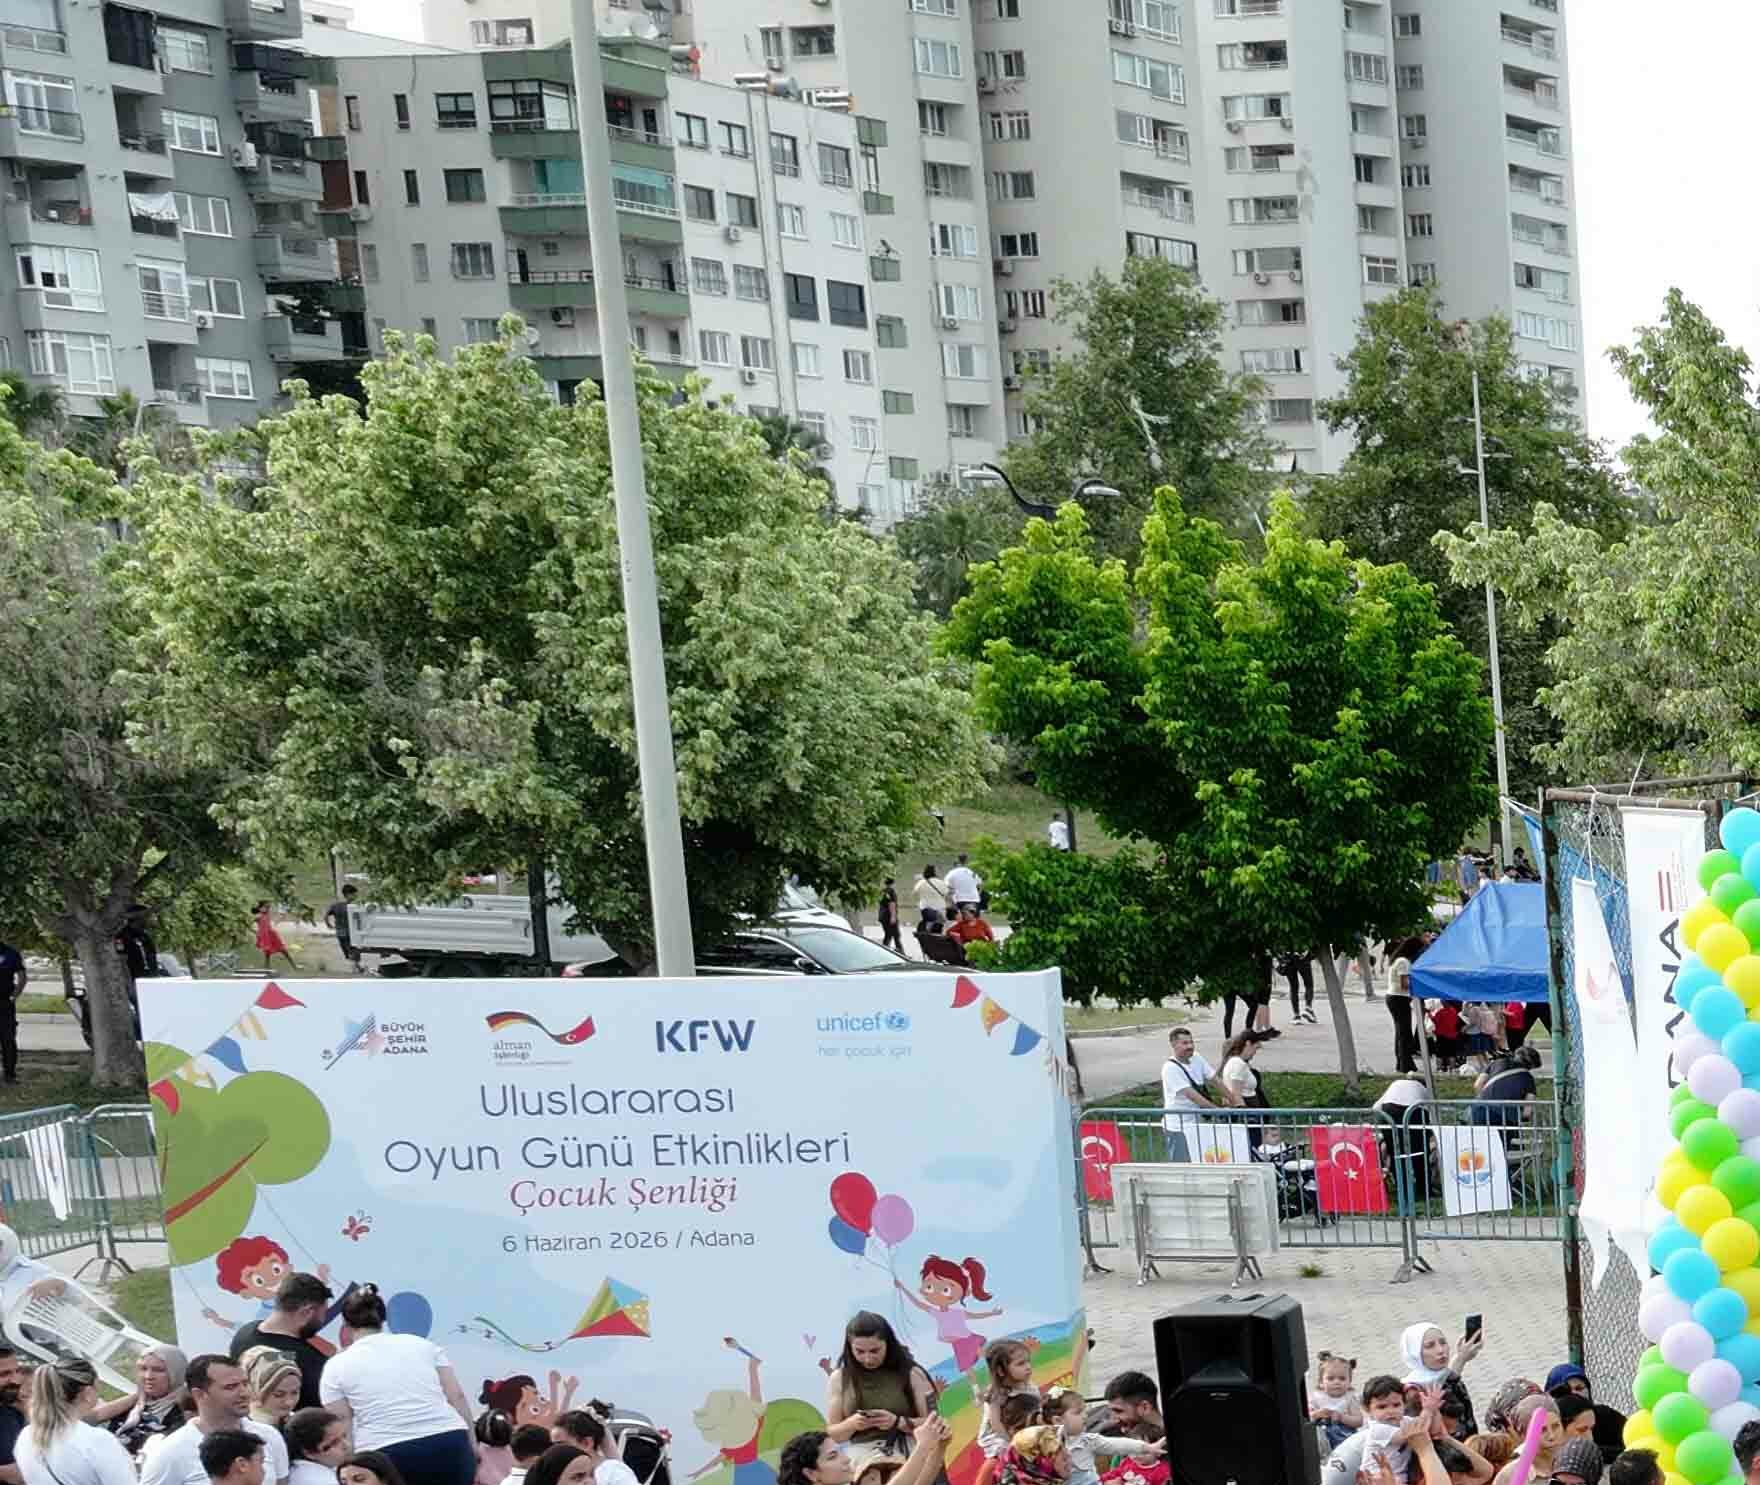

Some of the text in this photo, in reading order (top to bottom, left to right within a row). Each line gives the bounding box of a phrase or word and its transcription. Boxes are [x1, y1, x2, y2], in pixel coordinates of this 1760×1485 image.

[655, 1019, 755, 1052] KFW
[816, 1012, 884, 1032] unicef
[382, 1046, 428, 1055] ADANA
[480, 1083, 734, 1117] Uluslararası
[384, 1132, 850, 1181] Oyun Günü Etkinlikleri
[509, 1175, 738, 1216] Çocuk Şenliği
[502, 1230, 756, 1252] 6 Haziran 2026 / Adana
